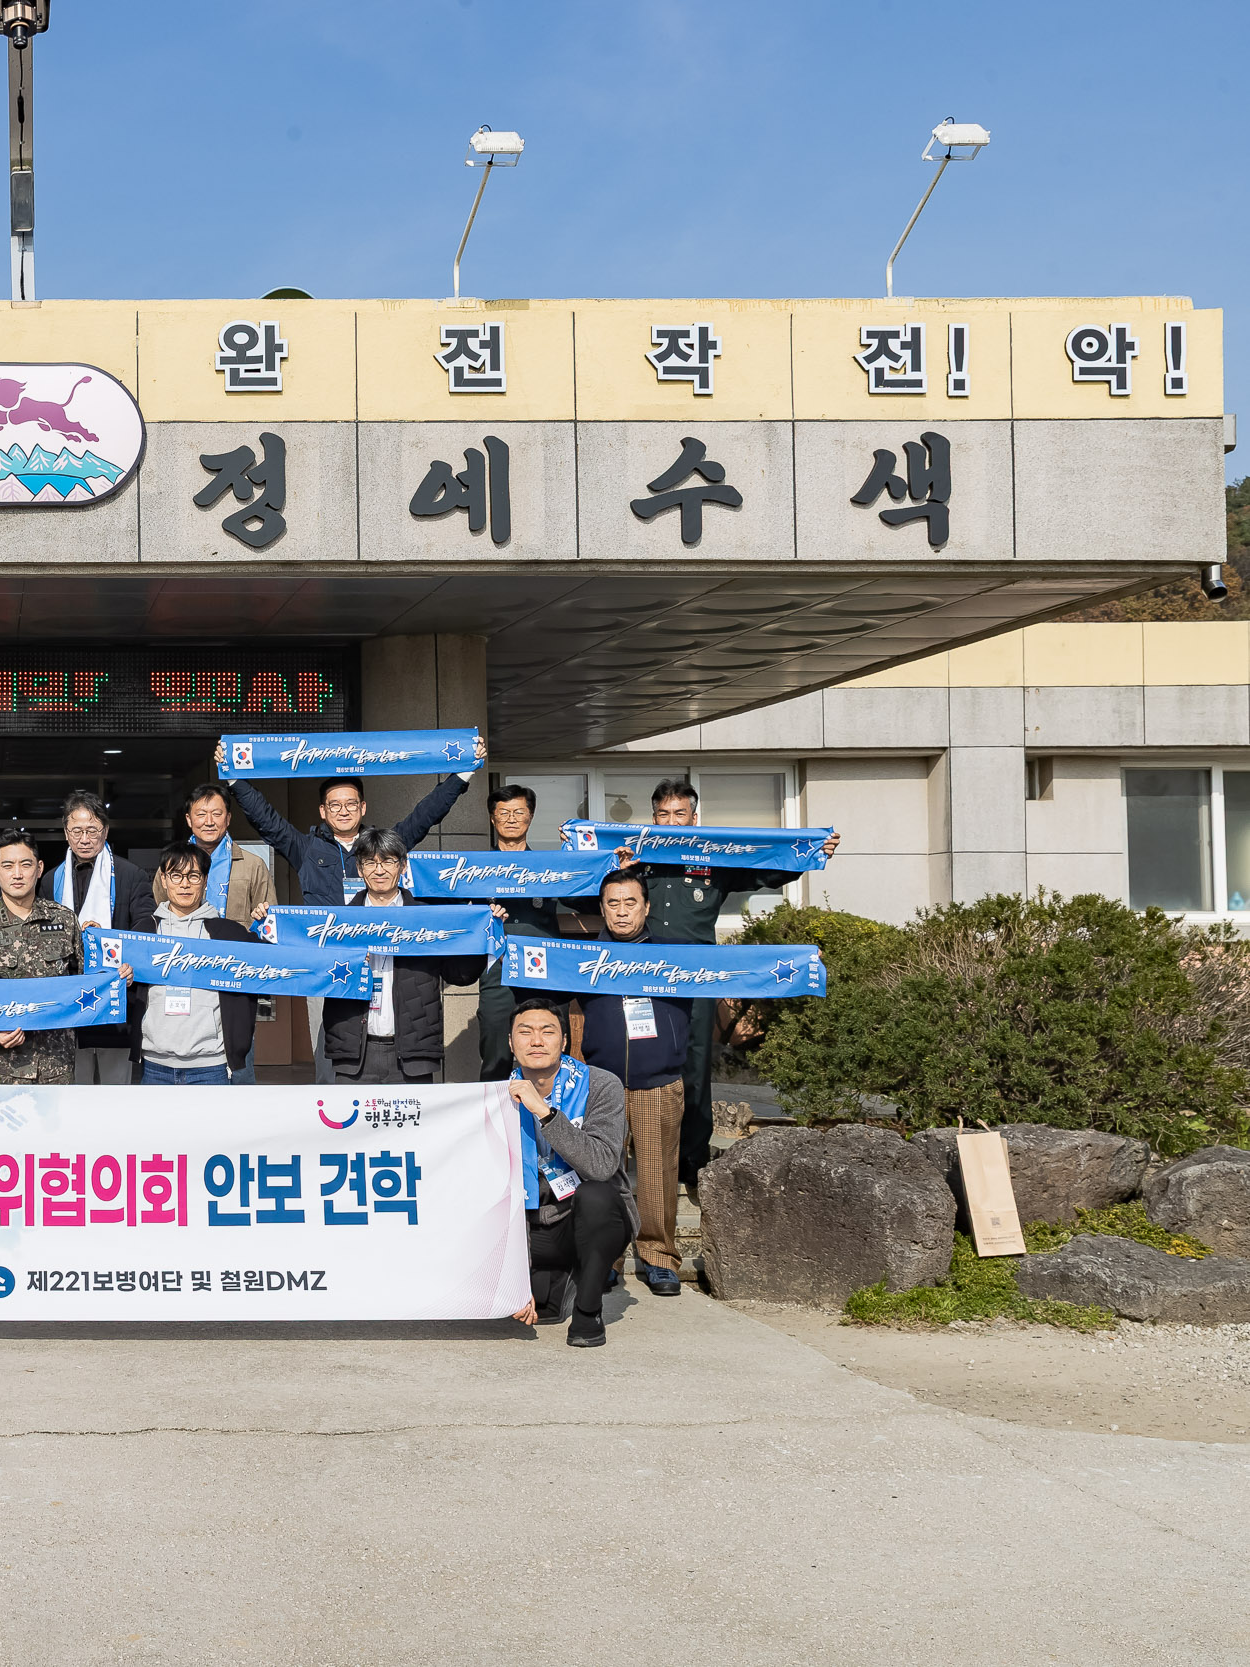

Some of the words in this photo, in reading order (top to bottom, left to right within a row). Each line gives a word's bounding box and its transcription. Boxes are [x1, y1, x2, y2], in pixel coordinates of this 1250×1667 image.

[365, 1109, 421, 1129] 행복광진
[204, 1153, 305, 1226] 안보
[319, 1150, 422, 1226] 견학
[26, 1269, 184, 1293] 제221보병여단
[192, 1269, 213, 1293] 및
[220, 1269, 328, 1293] 철원DMZ
